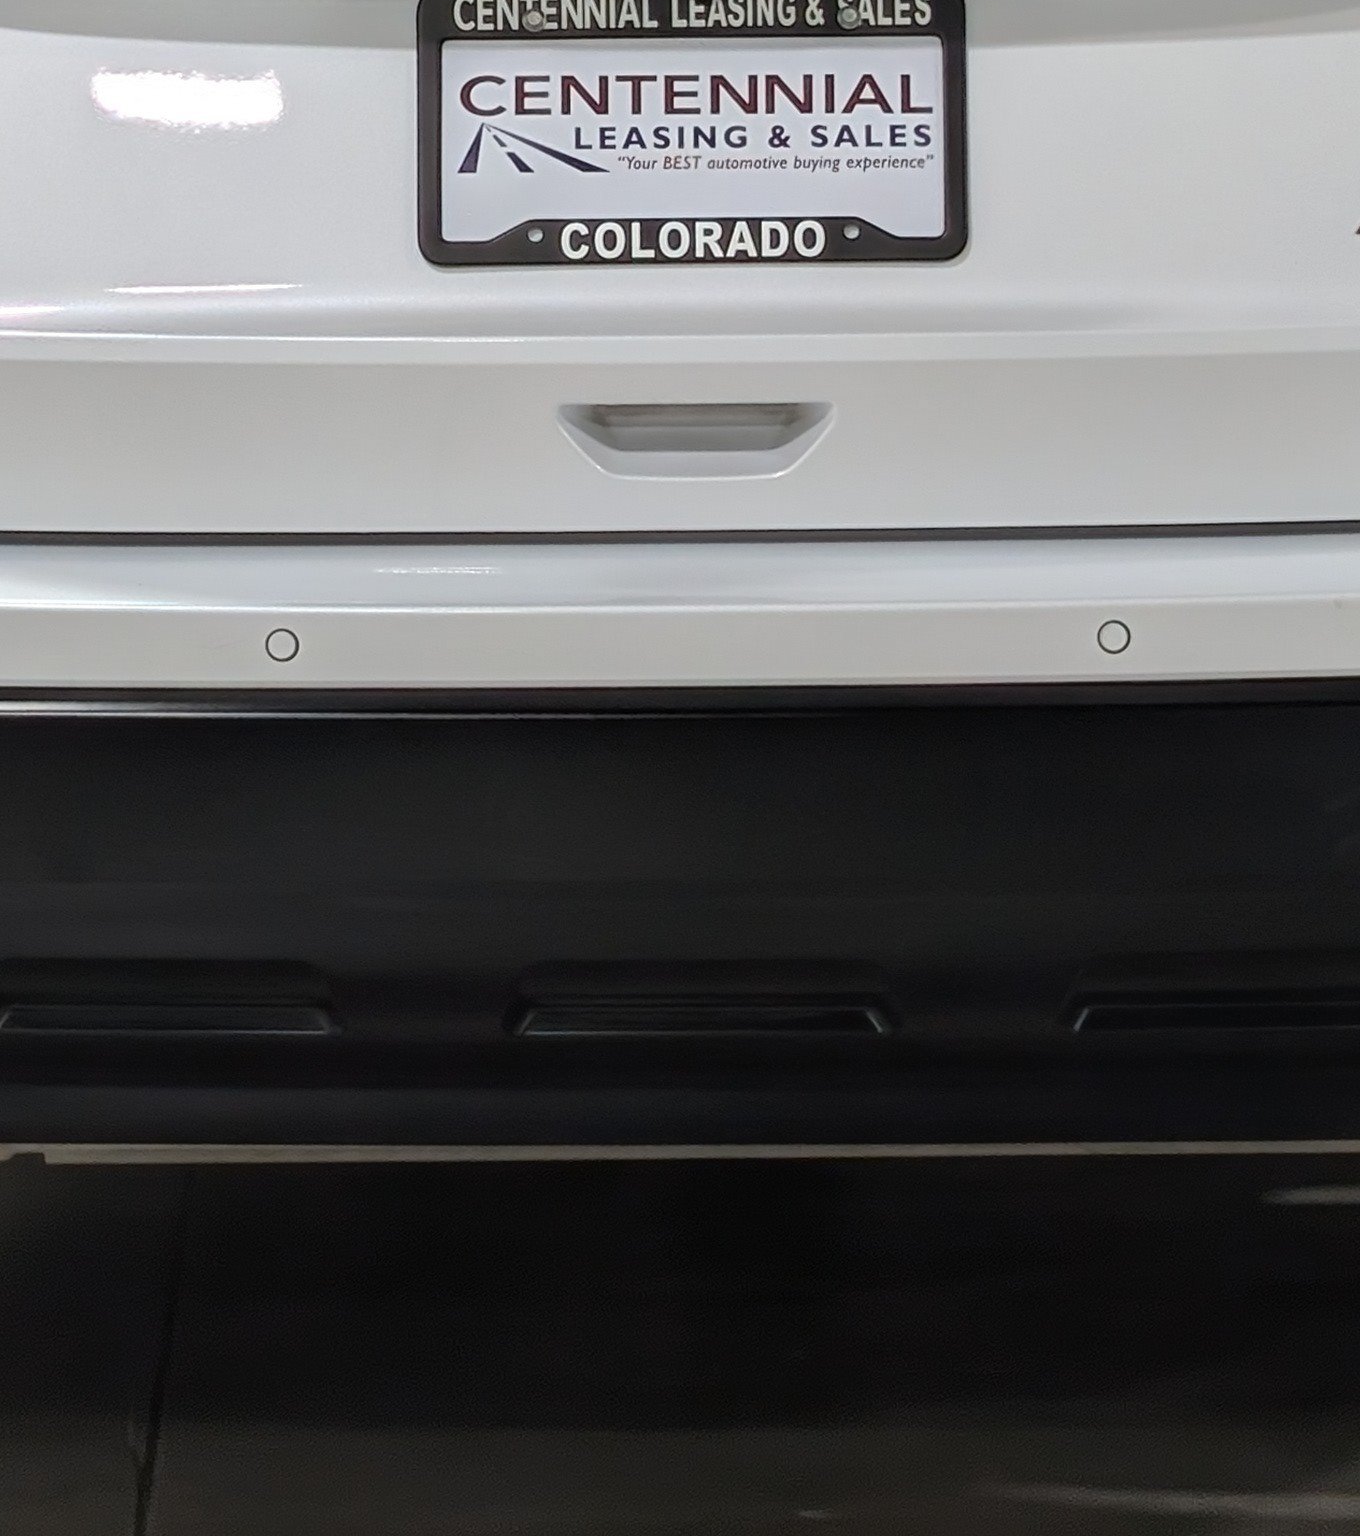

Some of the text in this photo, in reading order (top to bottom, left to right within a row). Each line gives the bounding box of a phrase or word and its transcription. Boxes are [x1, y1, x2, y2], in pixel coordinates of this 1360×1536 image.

[460, 74, 933, 116] CENTENNIAL
[574, 124, 932, 150] LEASING & SALES
[662, 156, 702, 170] BEST
[707, 155, 787, 169] automotive
[793, 155, 841, 173] buying
[561, 220, 826, 259] COLORADO
